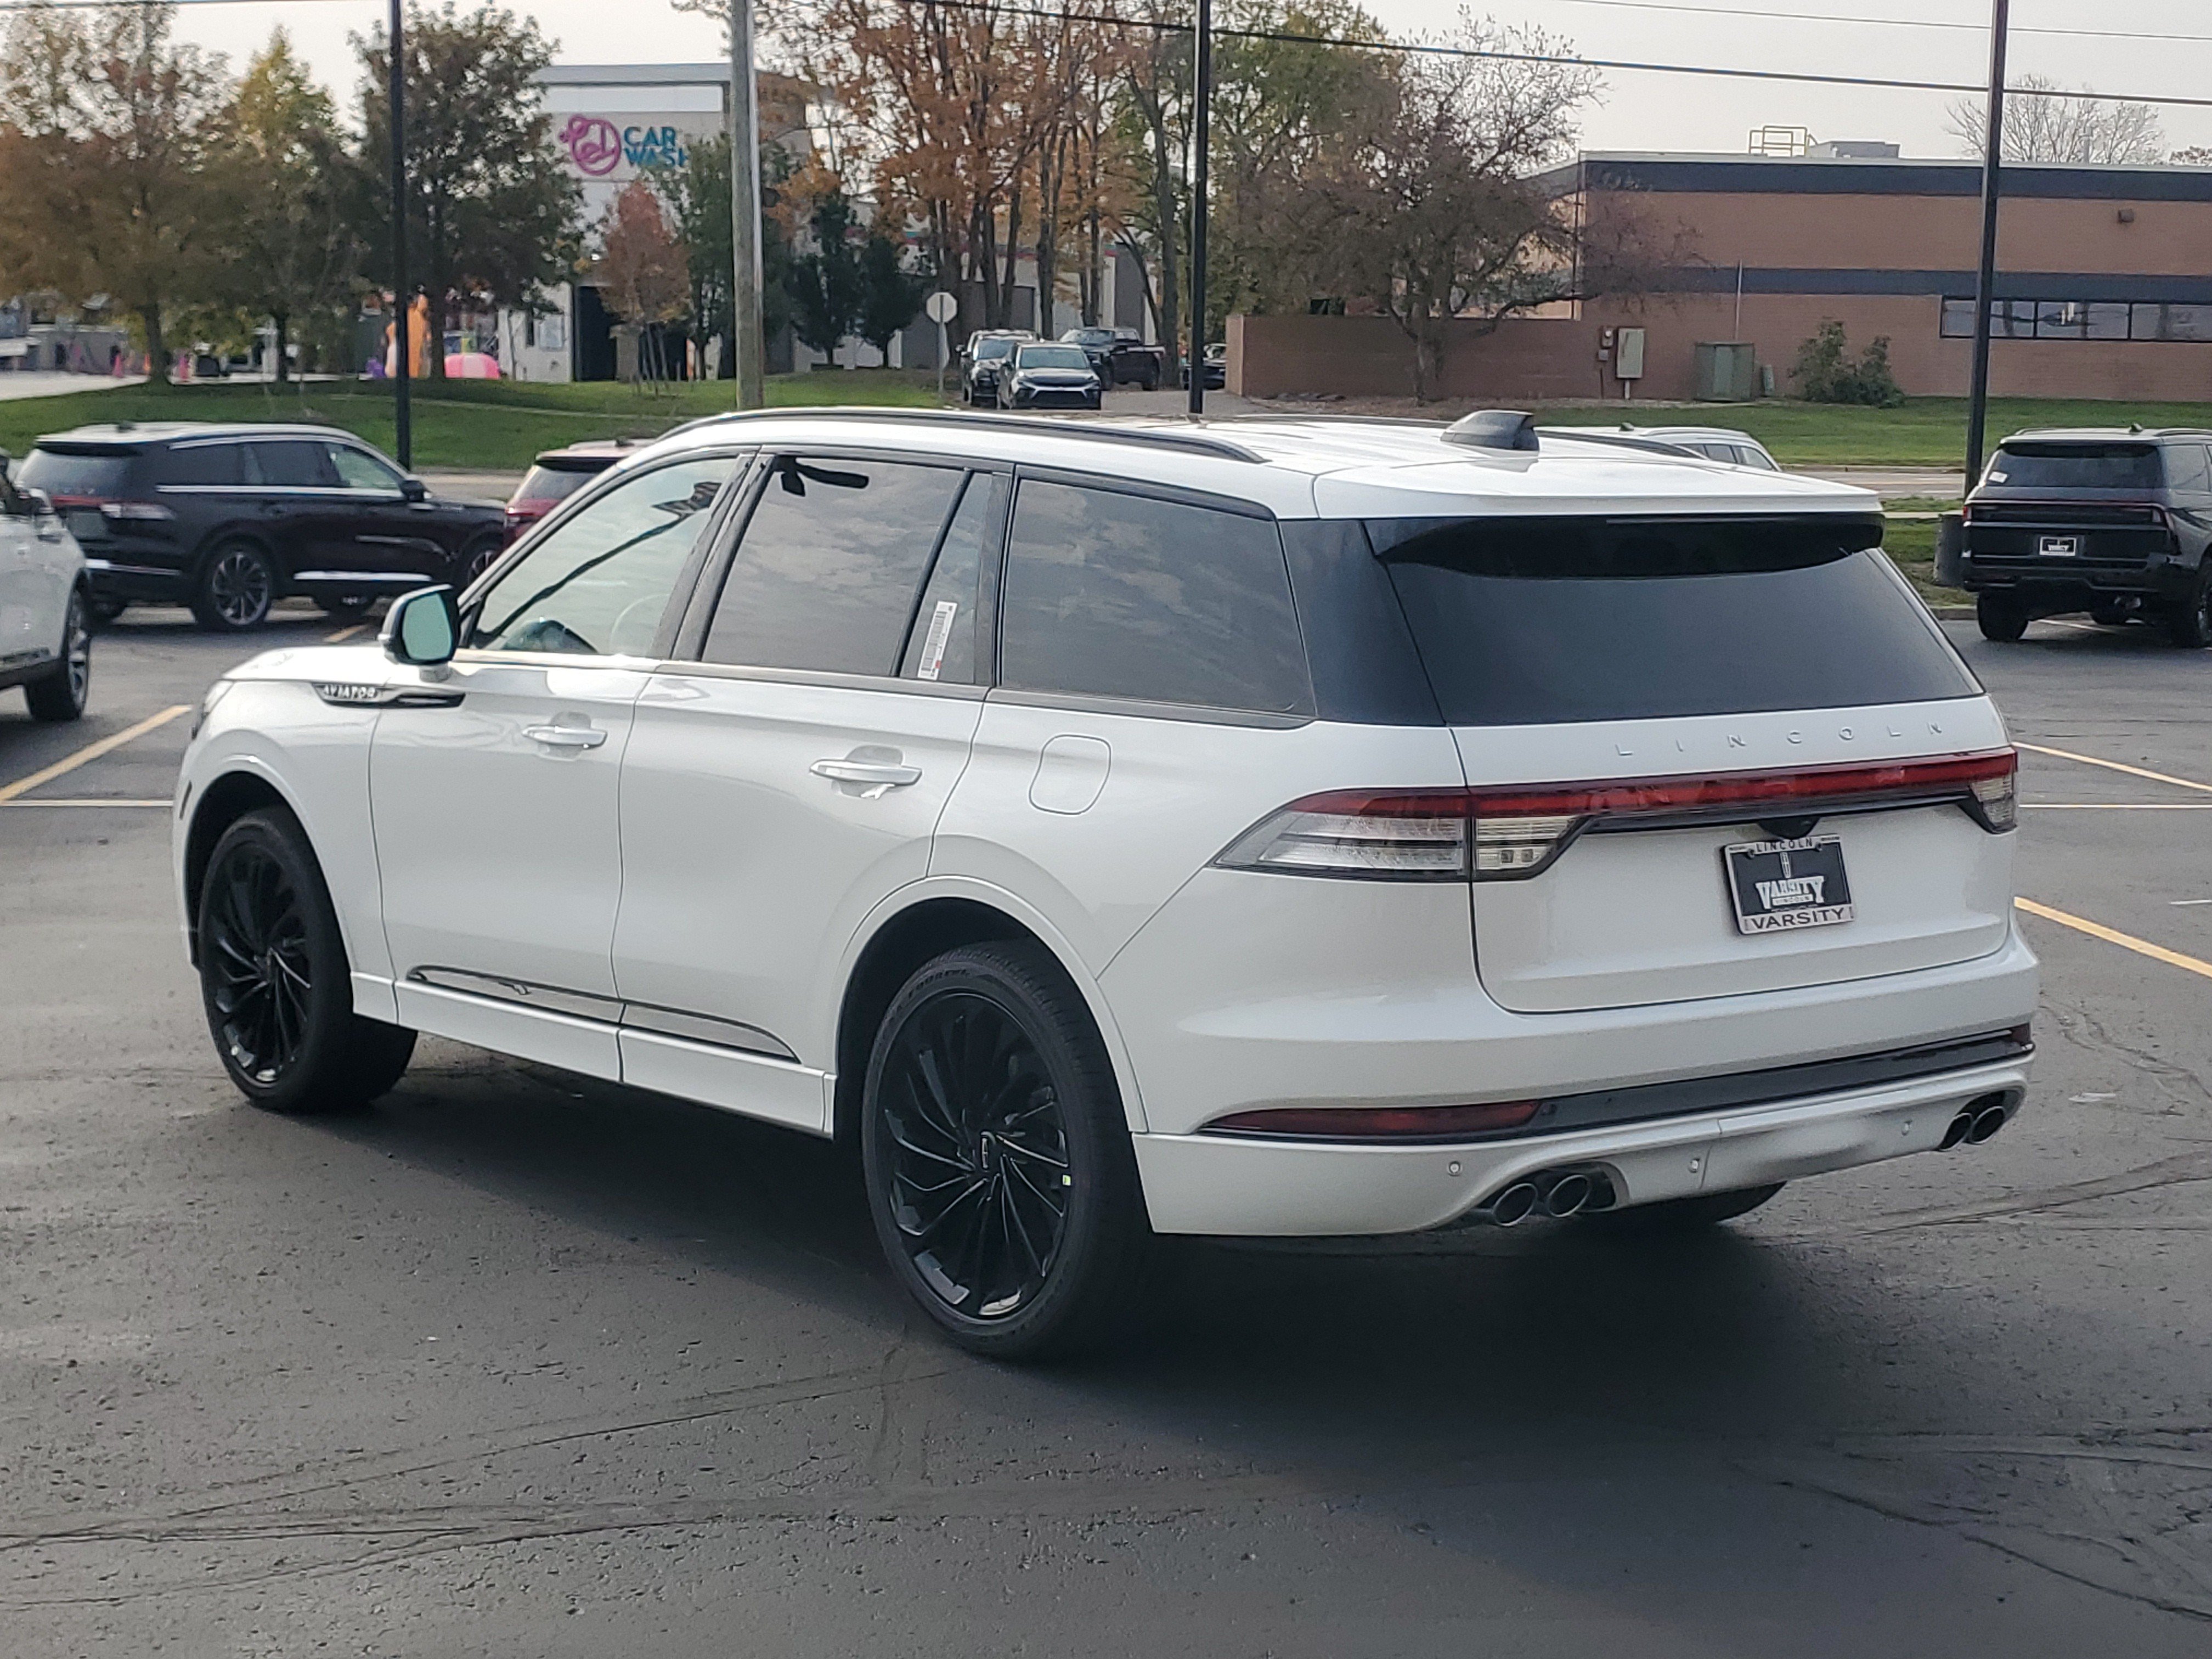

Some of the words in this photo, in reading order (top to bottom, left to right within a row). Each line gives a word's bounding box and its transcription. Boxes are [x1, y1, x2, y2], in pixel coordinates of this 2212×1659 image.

[624, 127, 676, 146] CAR
[1615, 720, 1942, 757] LINCOLN
[1757, 837, 1813, 853] LINCOLN
[1755, 876, 1824, 909] VARSITY
[1751, 907, 1844, 929] VARSITY
